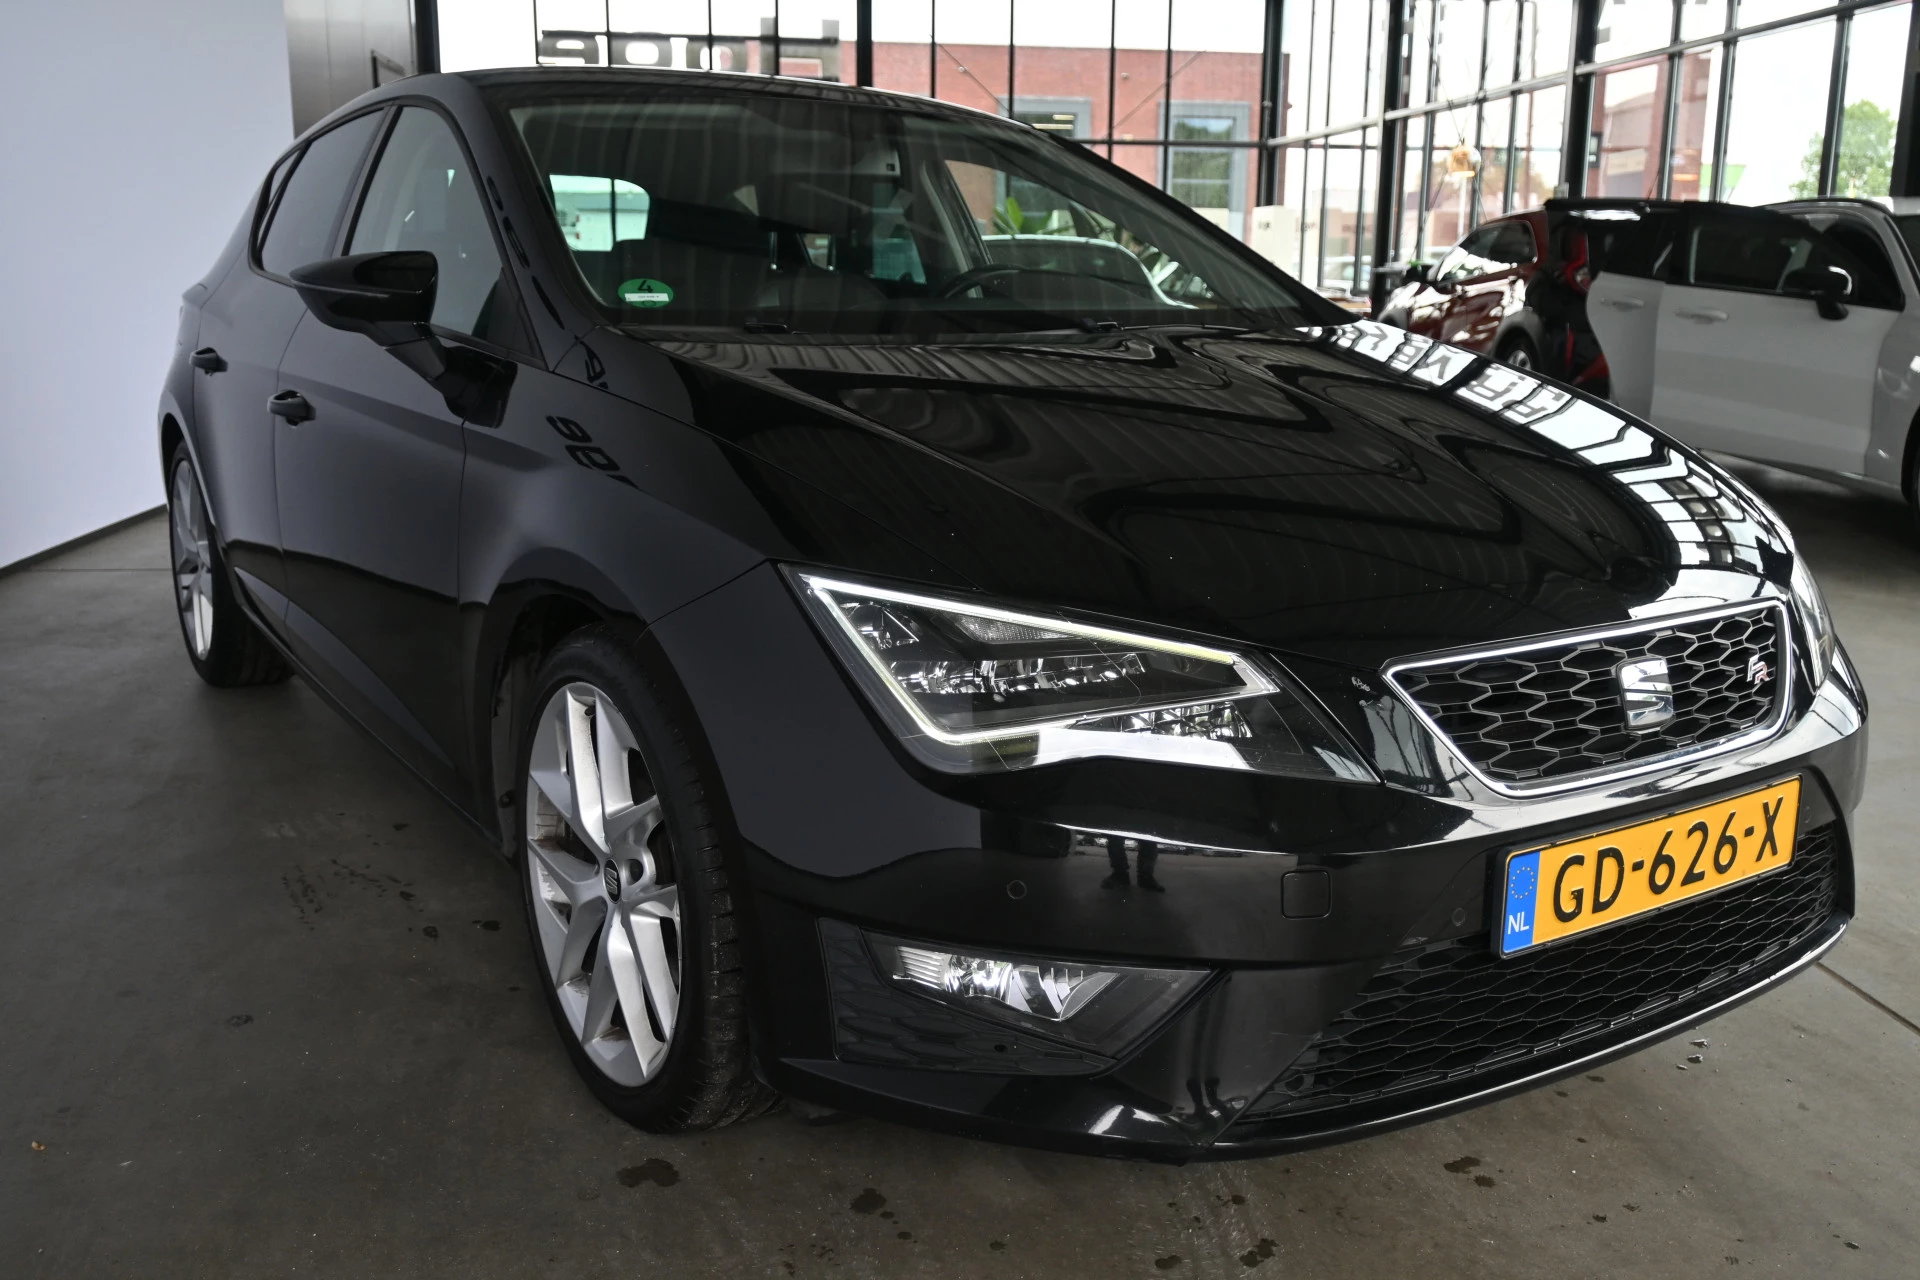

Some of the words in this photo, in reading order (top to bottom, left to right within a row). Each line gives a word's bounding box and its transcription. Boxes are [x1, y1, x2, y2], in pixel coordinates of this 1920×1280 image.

[637, 279, 654, 293] 4
[1553, 796, 1784, 923] GD-626-X
[1507, 911, 1530, 935] NL
